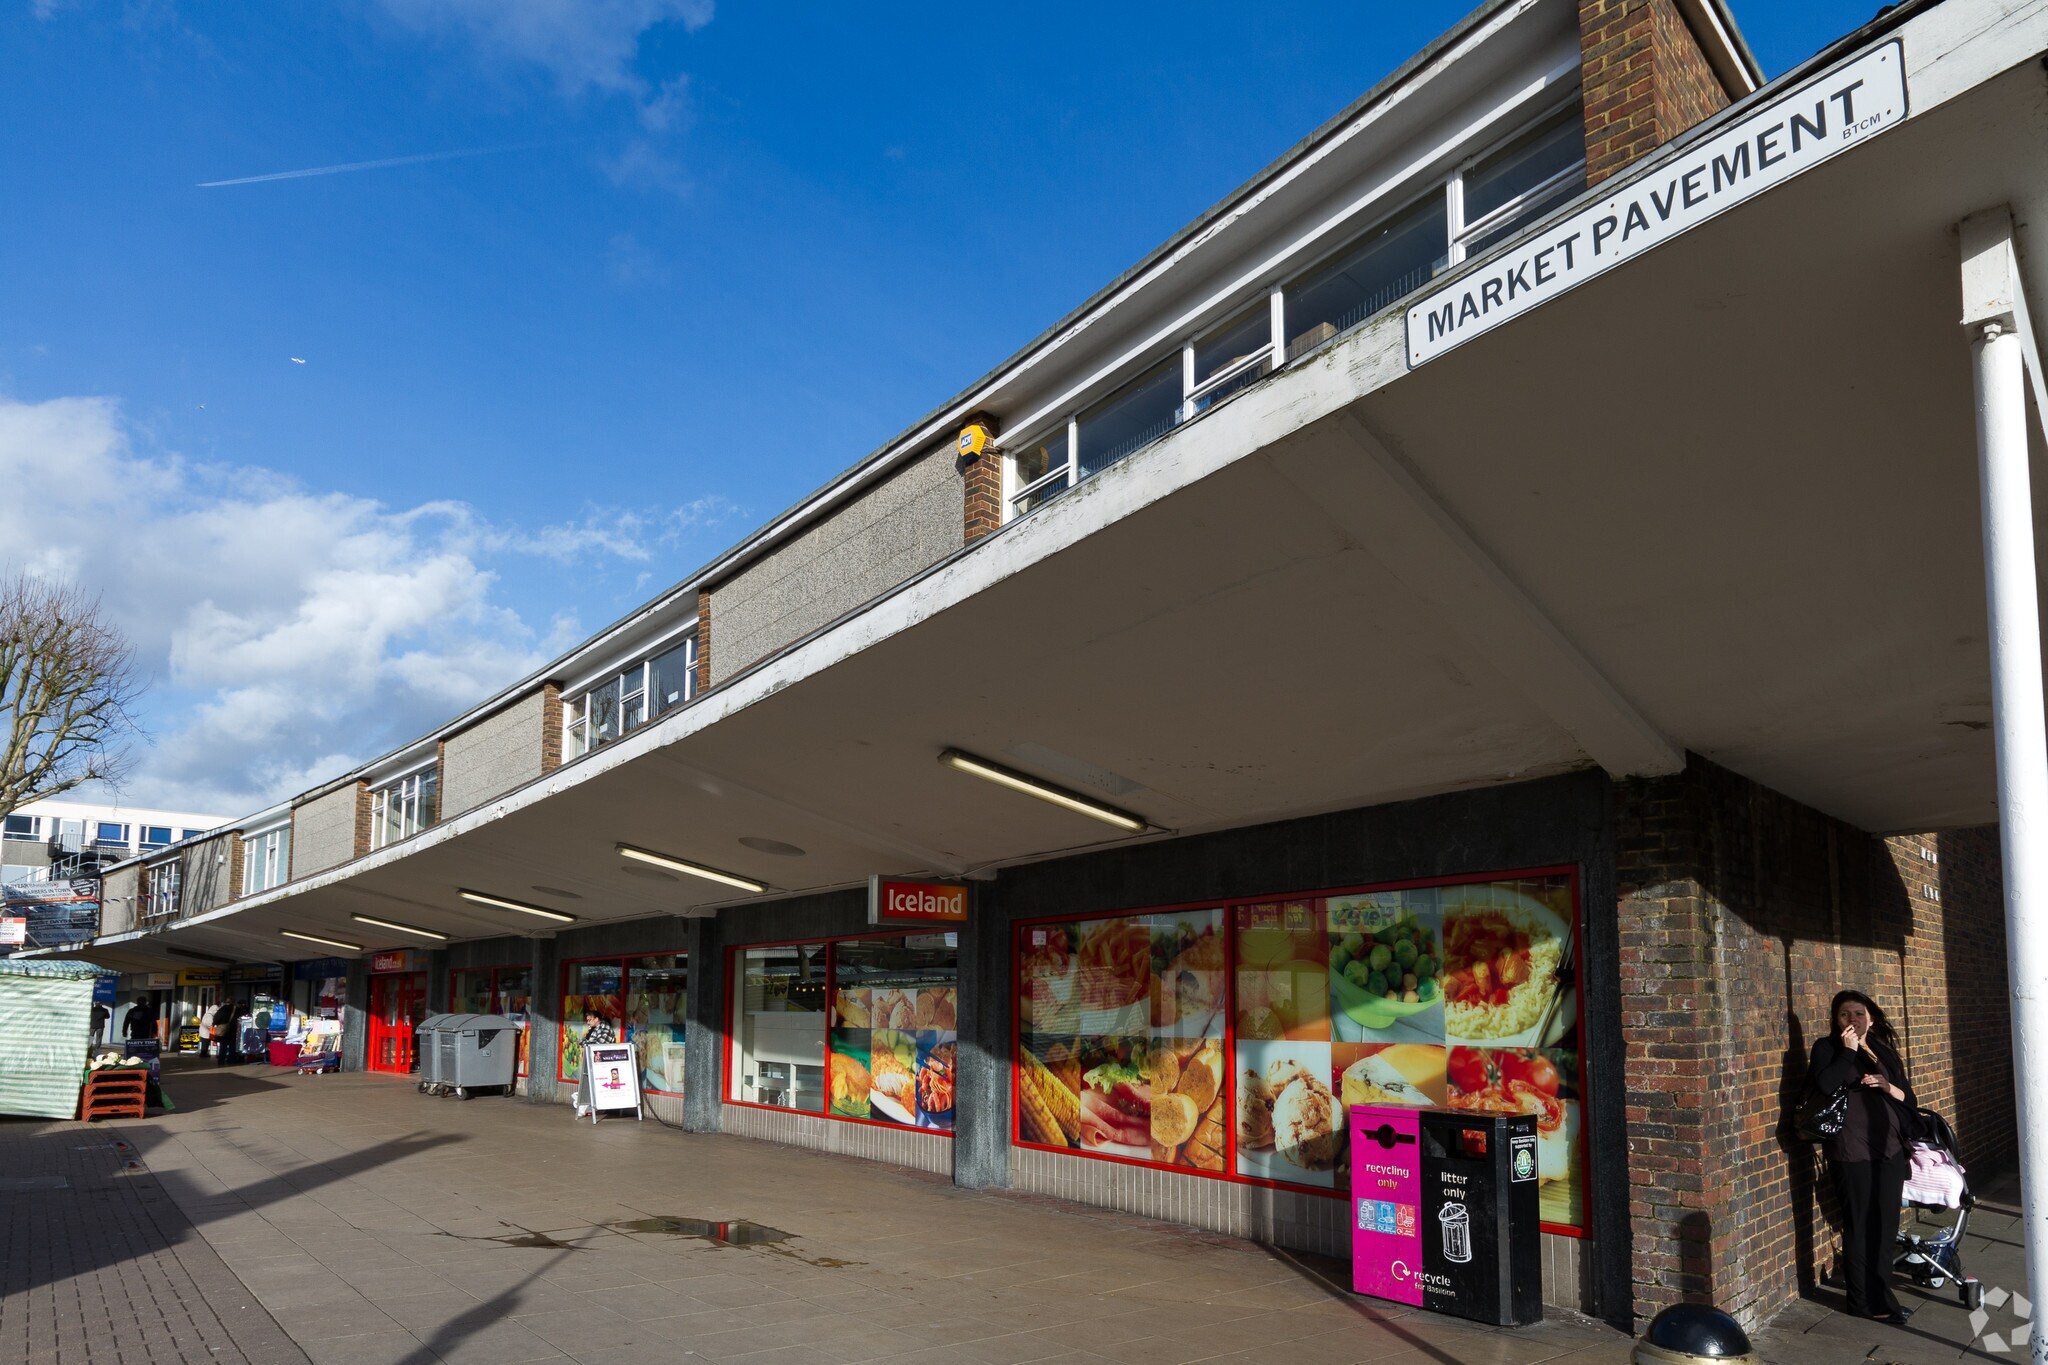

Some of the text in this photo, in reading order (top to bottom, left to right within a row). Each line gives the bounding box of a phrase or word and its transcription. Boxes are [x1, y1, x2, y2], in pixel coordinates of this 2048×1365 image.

[1843, 112, 1882, 141] BTCM
[1427, 79, 1864, 342] MARKET PAVEMENT
[888, 889, 962, 914] Iceland
[1366, 1163, 1410, 1178] recycling
[1377, 1179, 1398, 1190] only
[1441, 1172, 1468, 1185] litter
[1443, 1187, 1466, 1200] only
[1414, 1270, 1451, 1287] recycle
[1415, 1282, 1426, 1290] for
